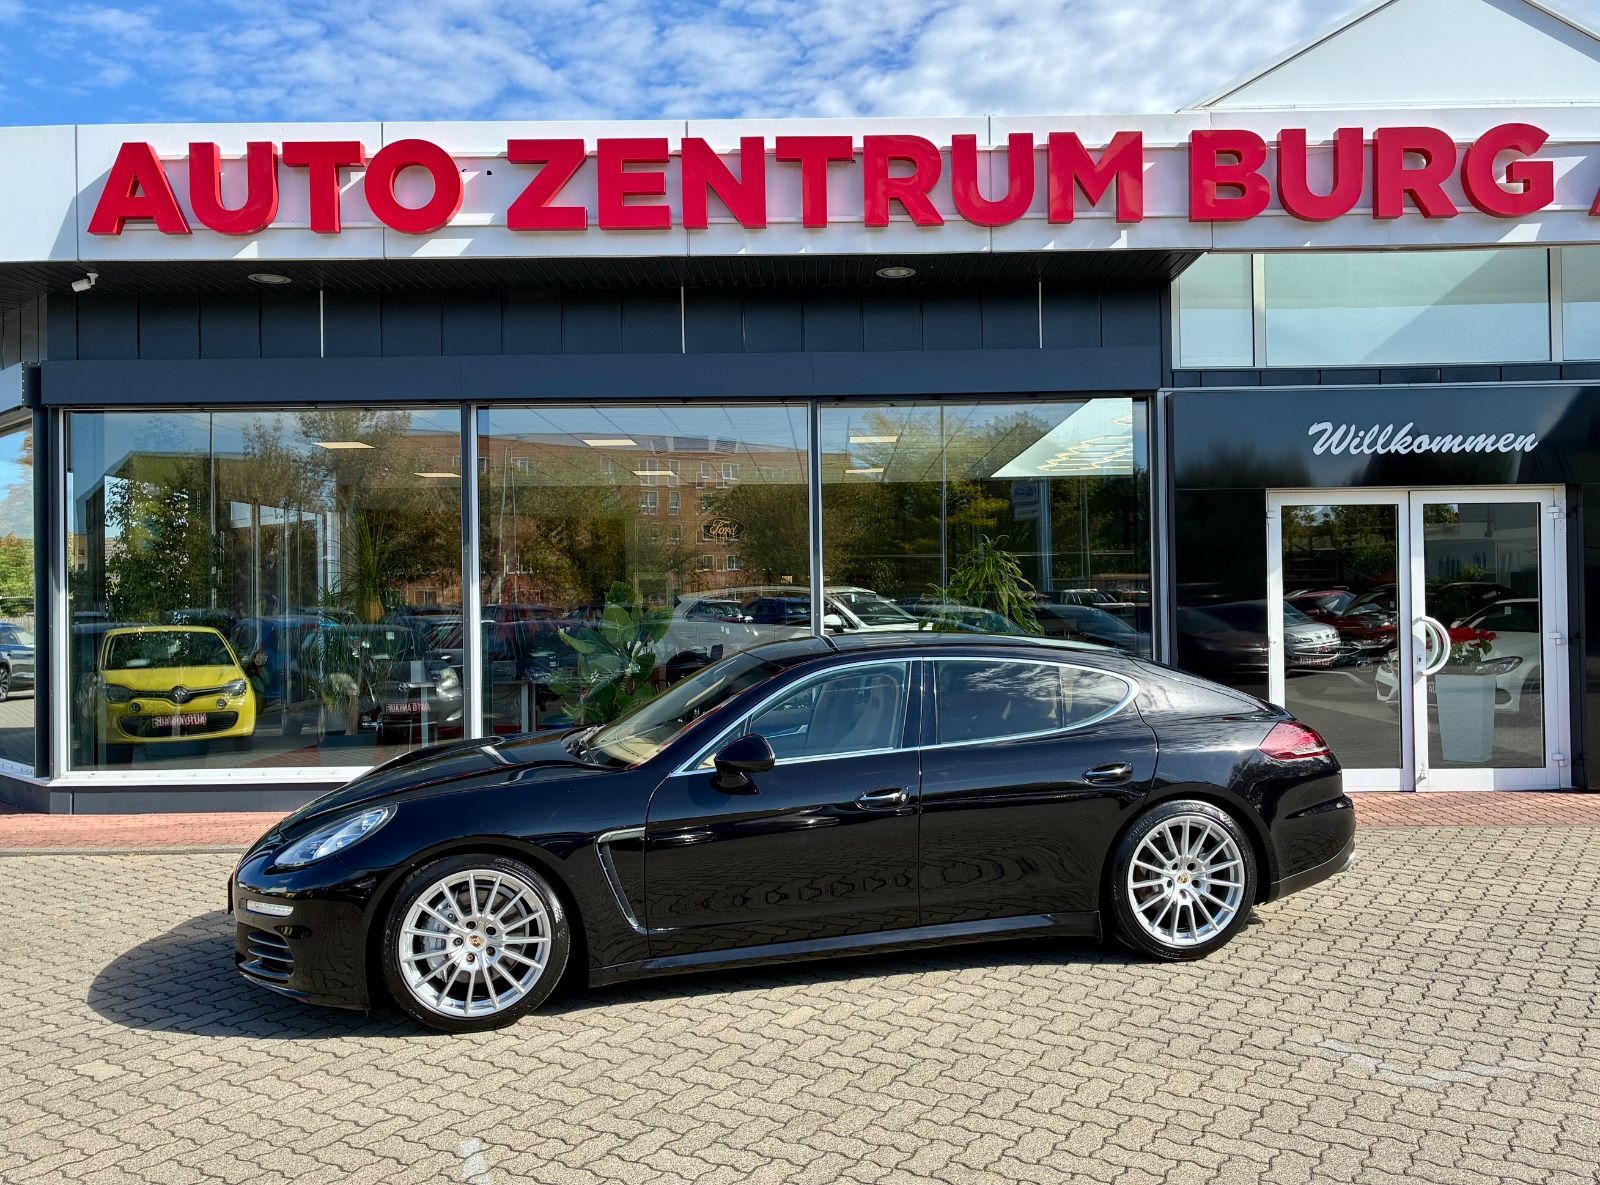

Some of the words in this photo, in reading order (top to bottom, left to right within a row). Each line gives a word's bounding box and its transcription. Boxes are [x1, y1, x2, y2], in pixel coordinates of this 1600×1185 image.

[88, 138, 465, 235] AUTO
[506, 131, 1145, 231] ZENTRUM
[1189, 123, 1555, 222] BURG
[1308, 421, 1539, 456] Willkommen
